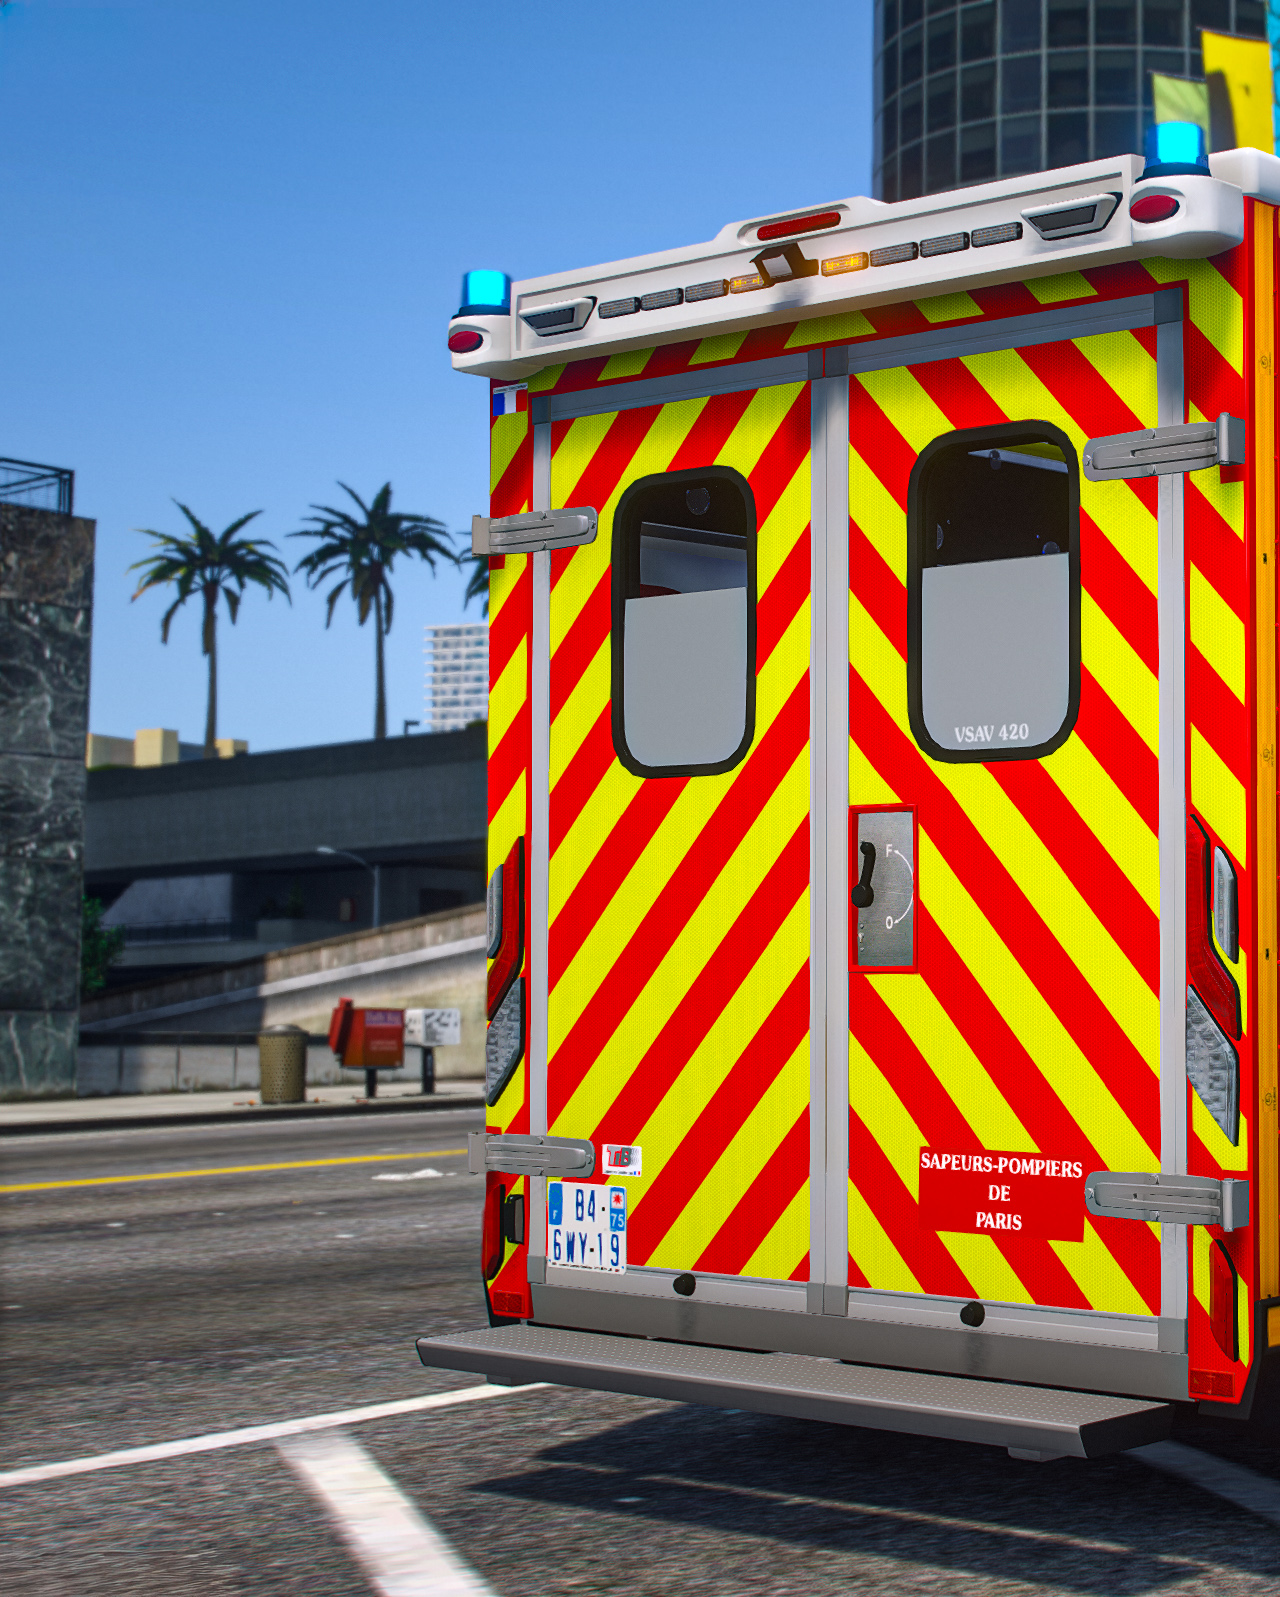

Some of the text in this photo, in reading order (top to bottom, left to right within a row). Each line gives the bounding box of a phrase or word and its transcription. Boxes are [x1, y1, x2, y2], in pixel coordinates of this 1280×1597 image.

[954, 723, 1029, 743] VSAV 420
[920, 1152, 1083, 1179] SAPEURS-POMPIERS
[988, 1184, 1011, 1202] DE
[610, 1213, 625, 1228] 75
[975, 1211, 1023, 1231] PARIS
[553, 1228, 620, 1267] 6WY-19
